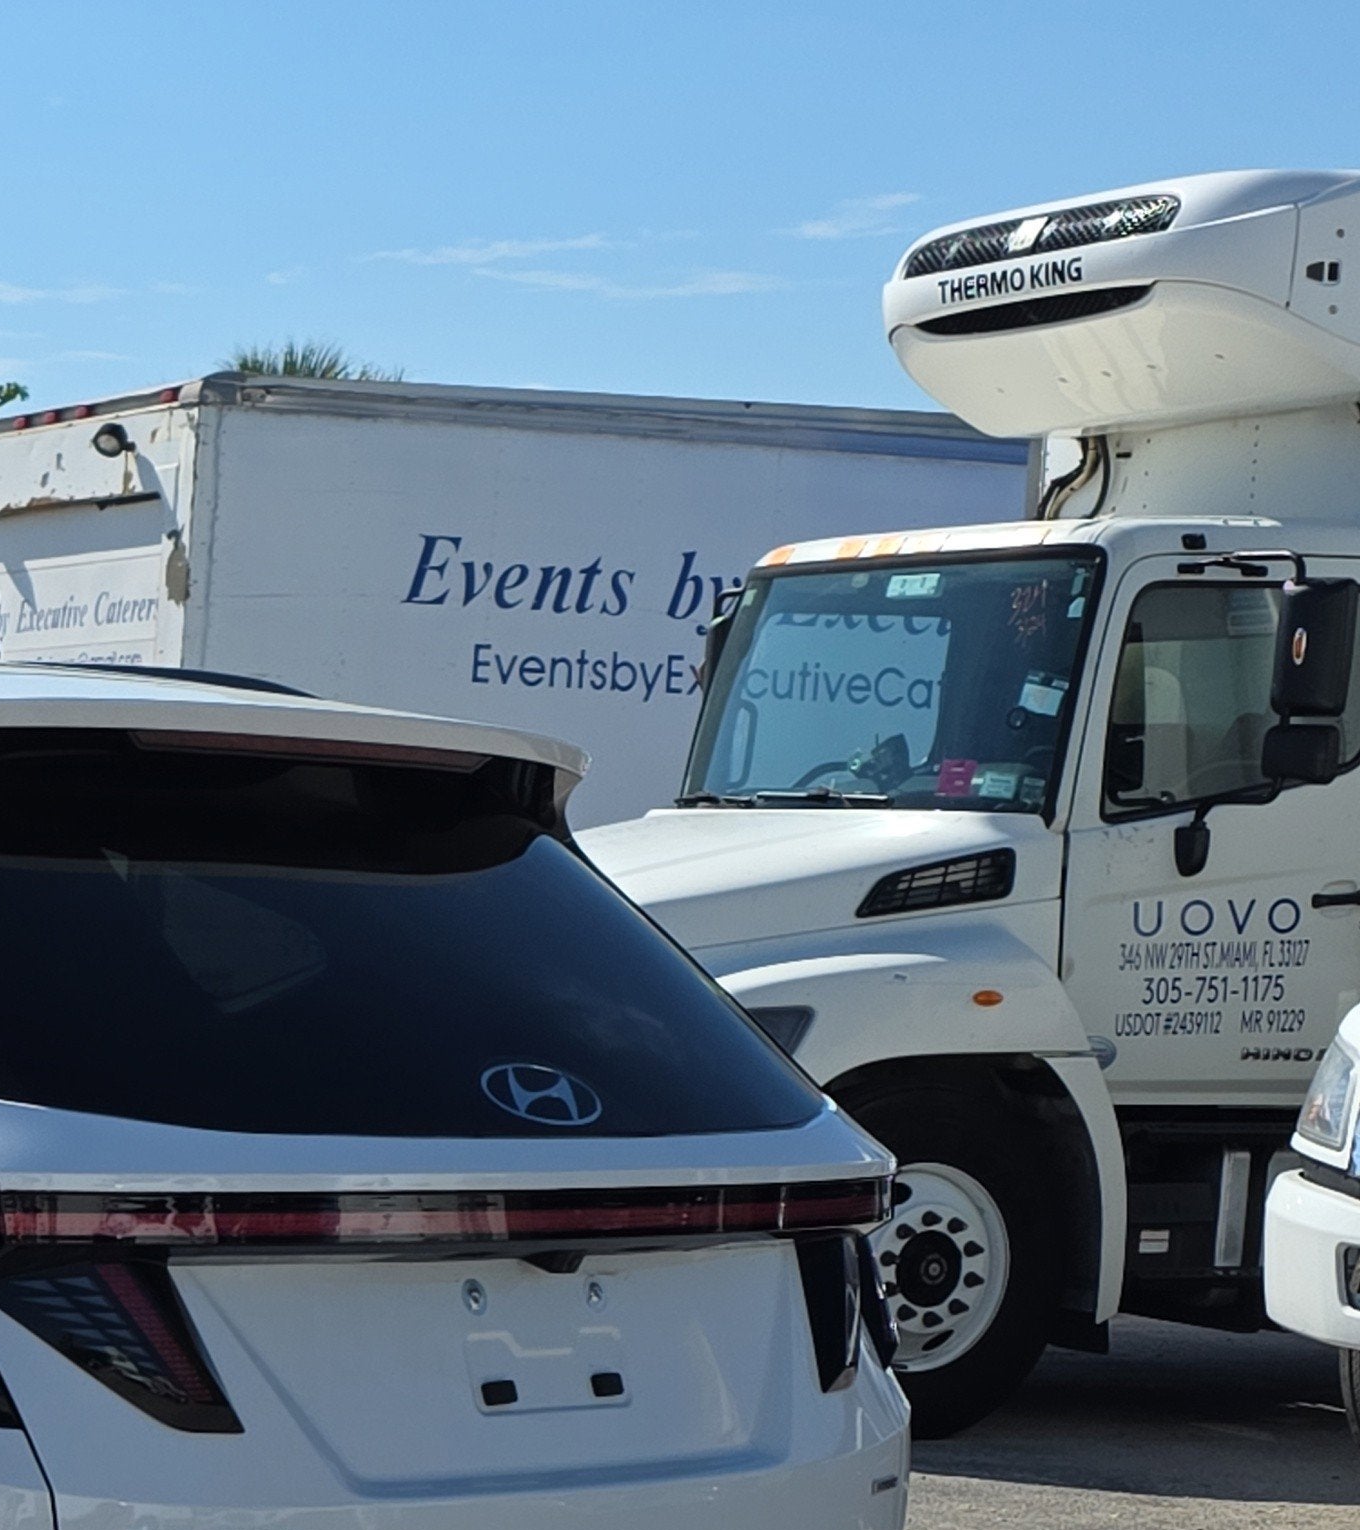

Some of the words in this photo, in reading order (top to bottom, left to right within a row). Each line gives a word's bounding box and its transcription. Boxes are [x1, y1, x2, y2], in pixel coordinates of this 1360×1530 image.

[938, 267, 1025, 304] THERMO
[1030, 256, 1083, 290] KING
[400, 533, 636, 616] Events
[15, 595, 89, 634] Executive
[1133, 898, 1301, 937] UOVO
[1119, 942, 1142, 971] 346
[1144, 943, 1168, 970] NW
[1169, 941, 1201, 969] 29TH
[1262, 940, 1275, 967] FL
[1277, 939, 1311, 968] 33127
[1141, 974, 1285, 1005] 305-751-1175
[1115, 1012, 1161, 1036] USDOT
[1240, 1010, 1262, 1033] MR
[1267, 1008, 1306, 1033] 91229
